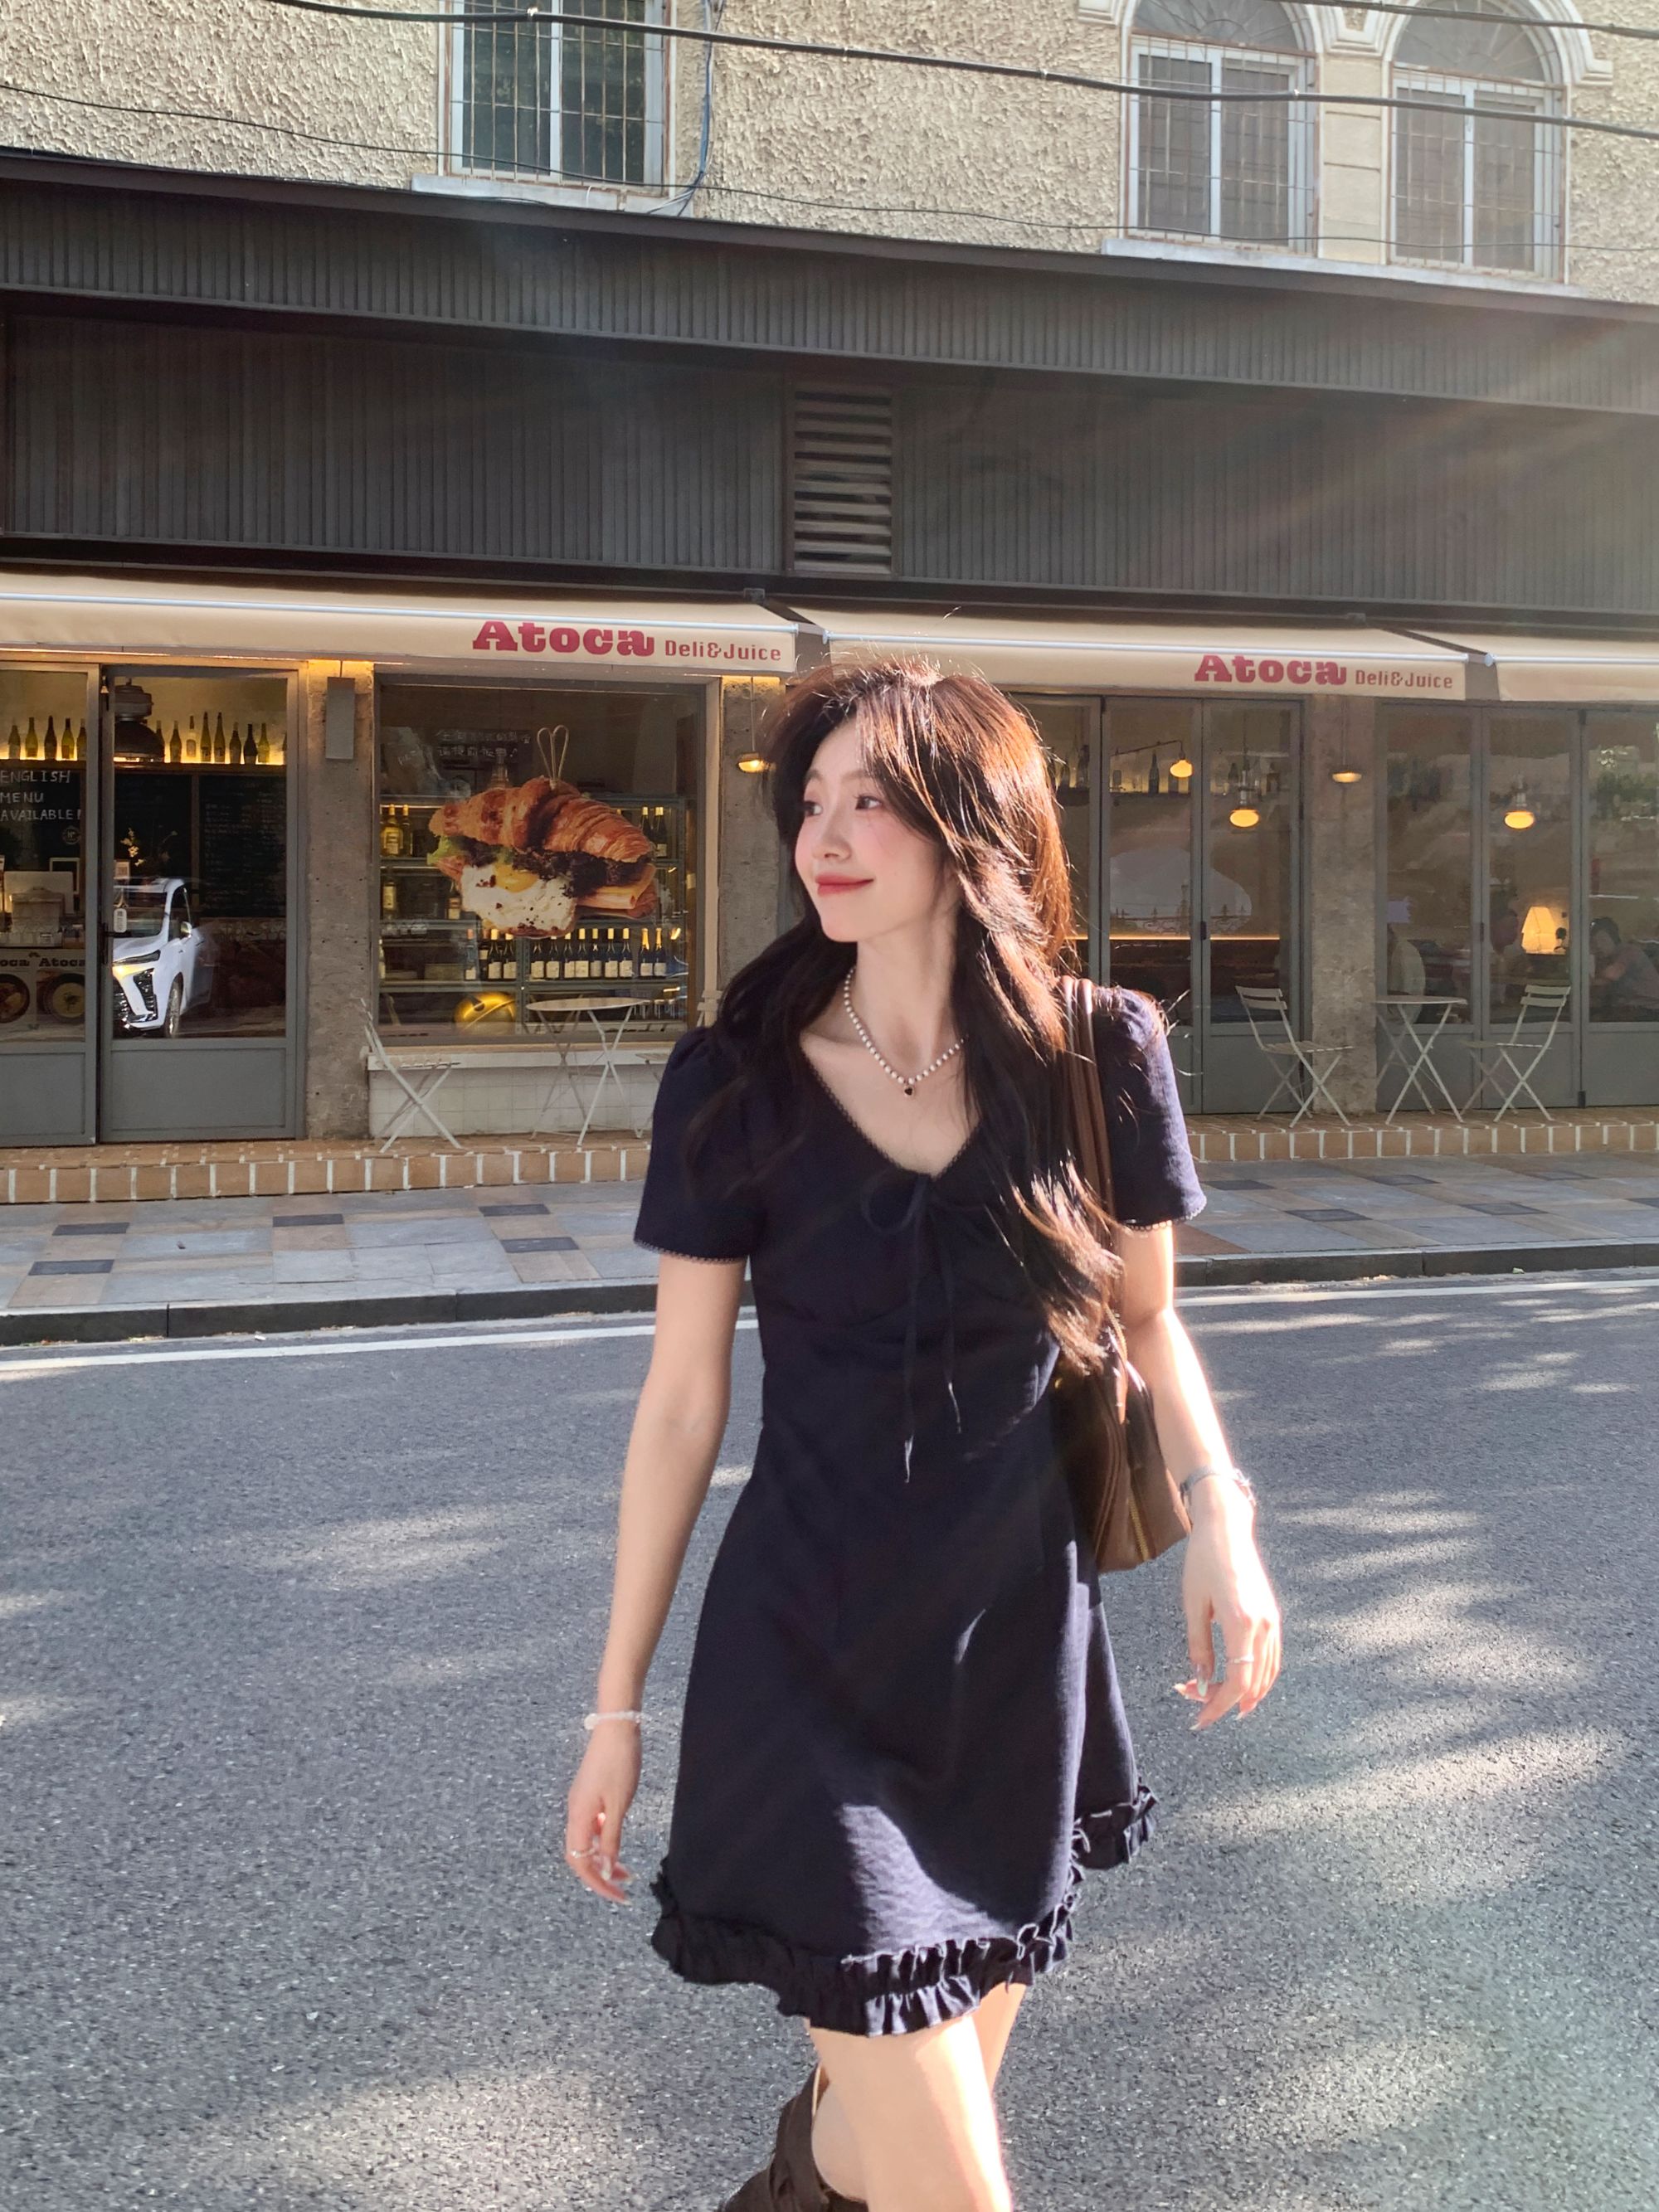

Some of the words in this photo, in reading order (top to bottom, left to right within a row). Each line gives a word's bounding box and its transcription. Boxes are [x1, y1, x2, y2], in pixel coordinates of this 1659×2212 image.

[473, 620, 655, 657] Atoca
[664, 639, 781, 661] Deli&Juice
[1194, 654, 1347, 686] Atoca
[1355, 669, 1453, 689] Deli&Juice
[0, 770, 71, 783] ENGLISH
[0, 791, 44, 805] MENU
